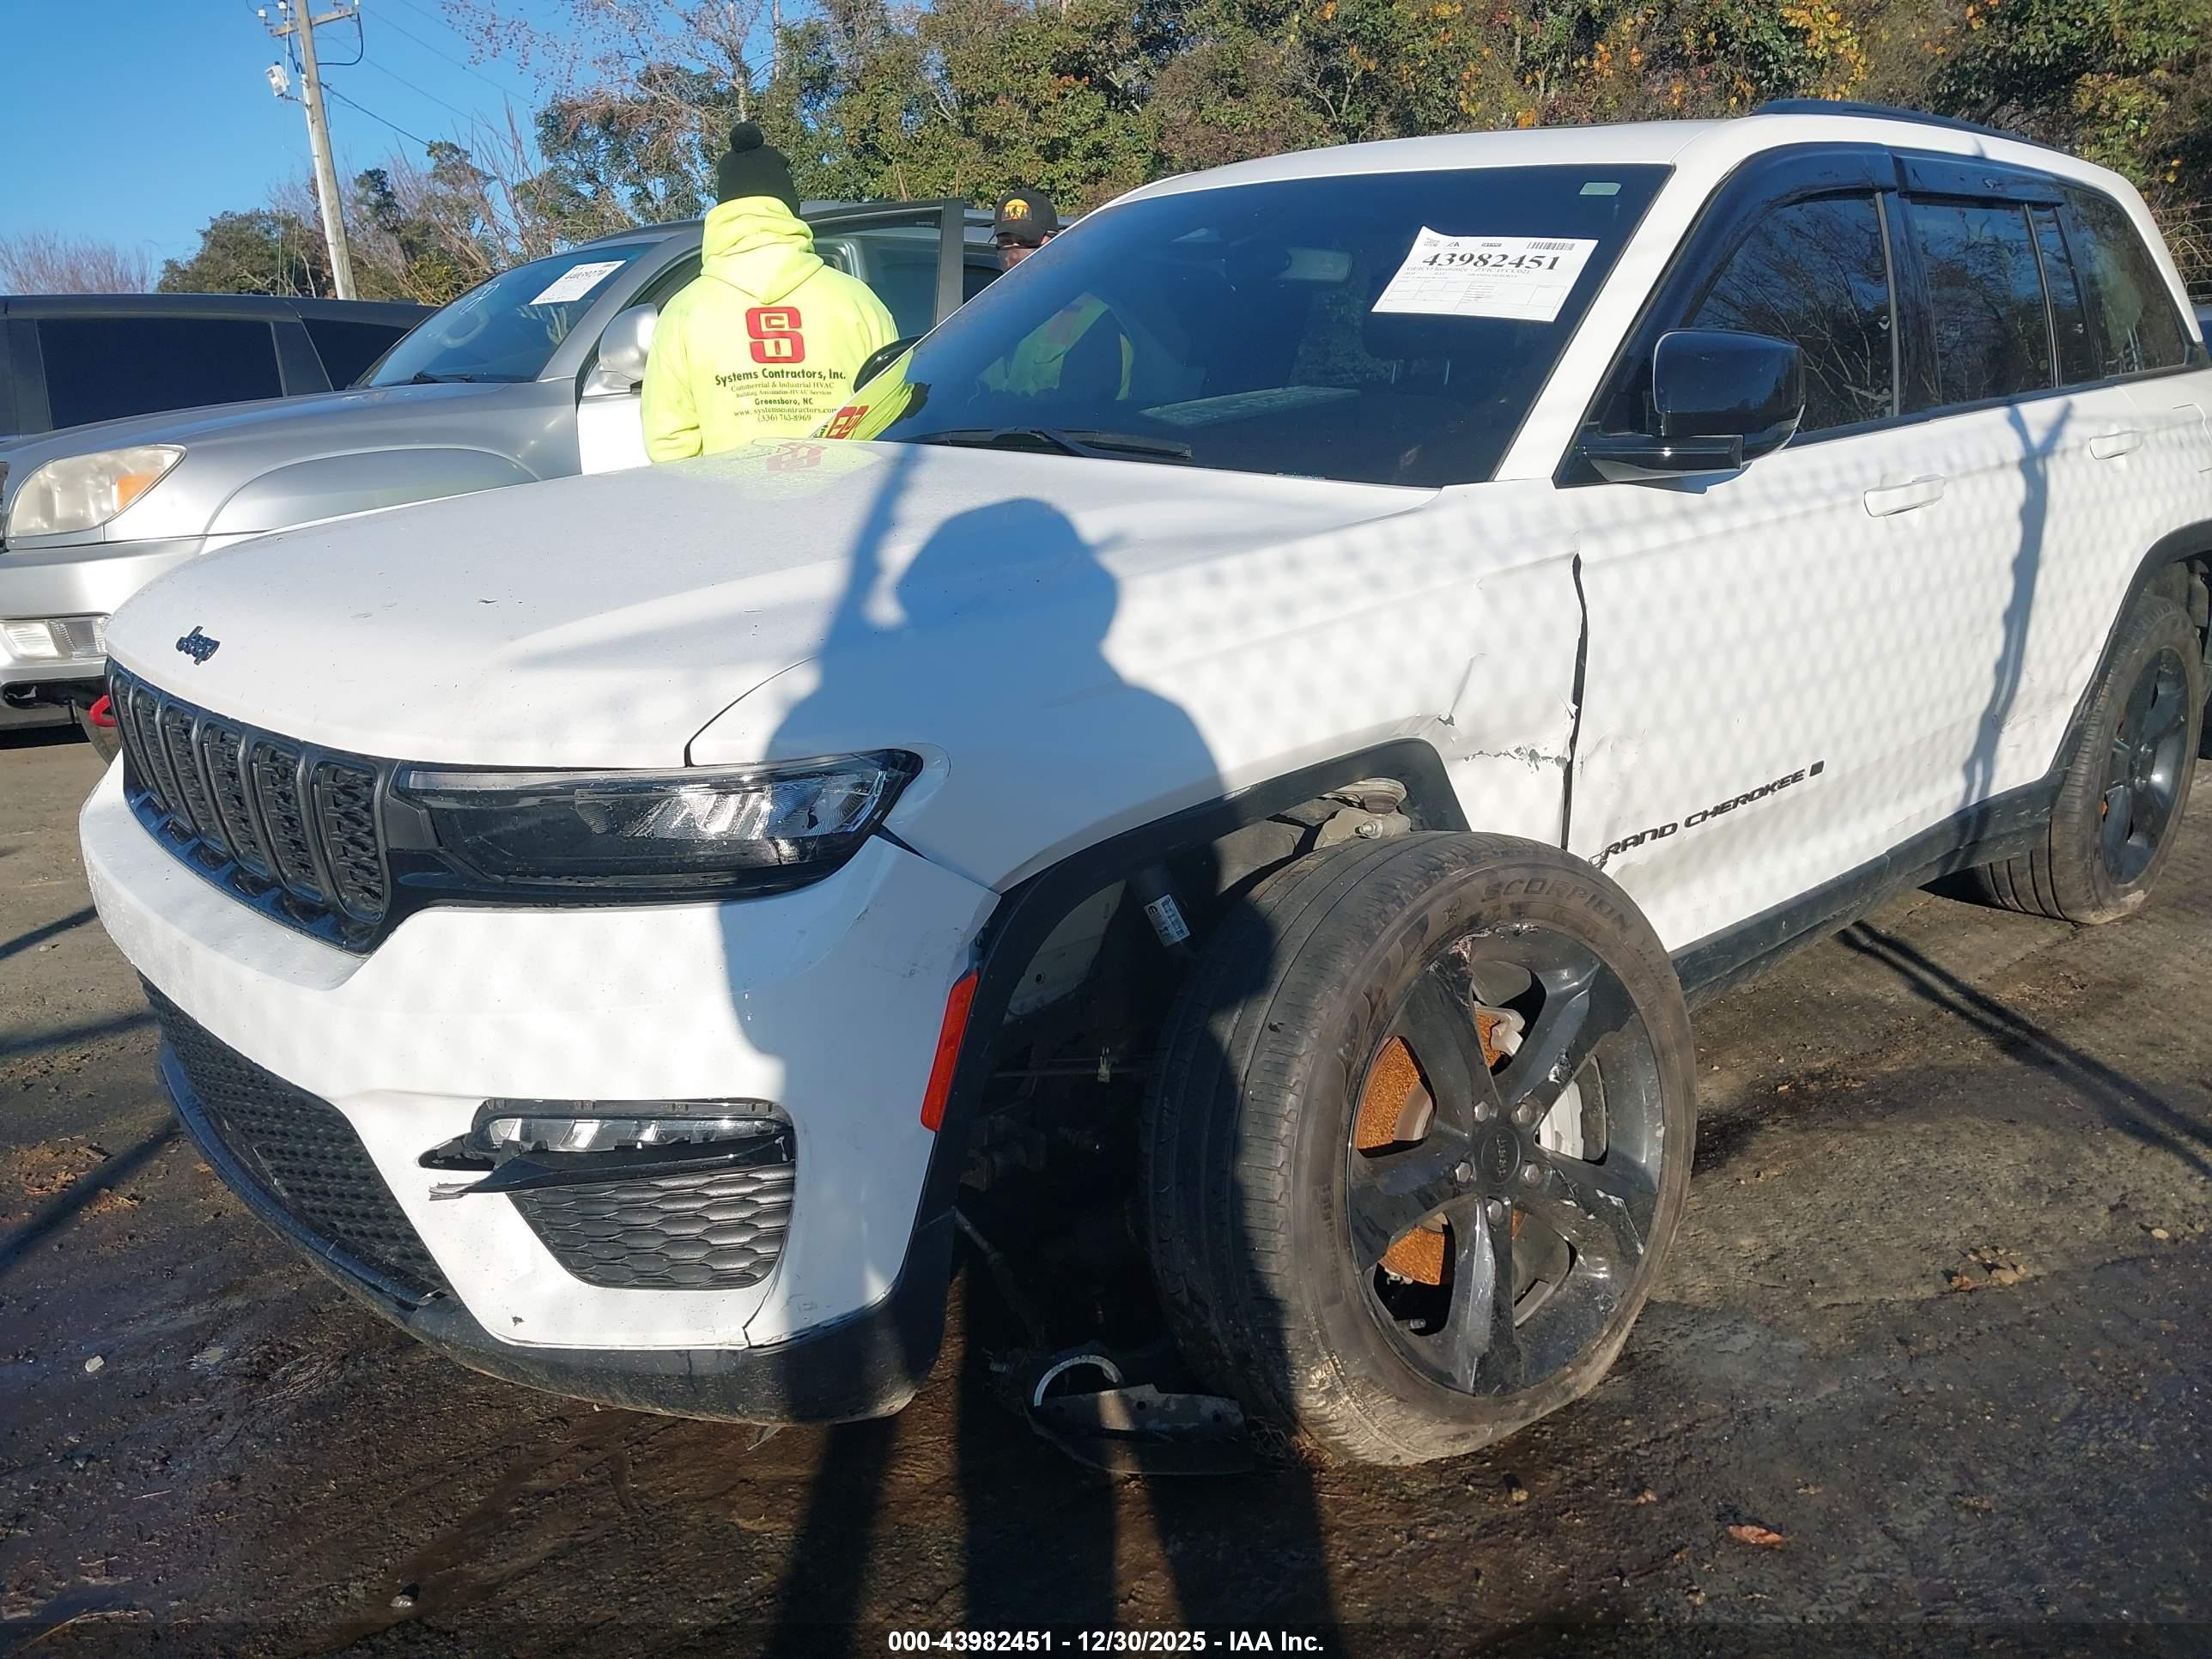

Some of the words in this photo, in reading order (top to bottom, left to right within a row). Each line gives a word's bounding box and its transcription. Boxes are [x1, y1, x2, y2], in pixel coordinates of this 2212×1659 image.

[1422, 252, 1560, 270] 43982451
[715, 371, 759, 387] Systems
[762, 368, 826, 380] Contractors,
[829, 368, 846, 380] Inc.
[731, 382, 770, 392] Commercial
[757, 414, 778, 422] (336)
[176, 625, 221, 666] Jeep
[1684, 769, 1806, 828] CHEROKEE
[1481, 877, 1632, 934] SCORPION
